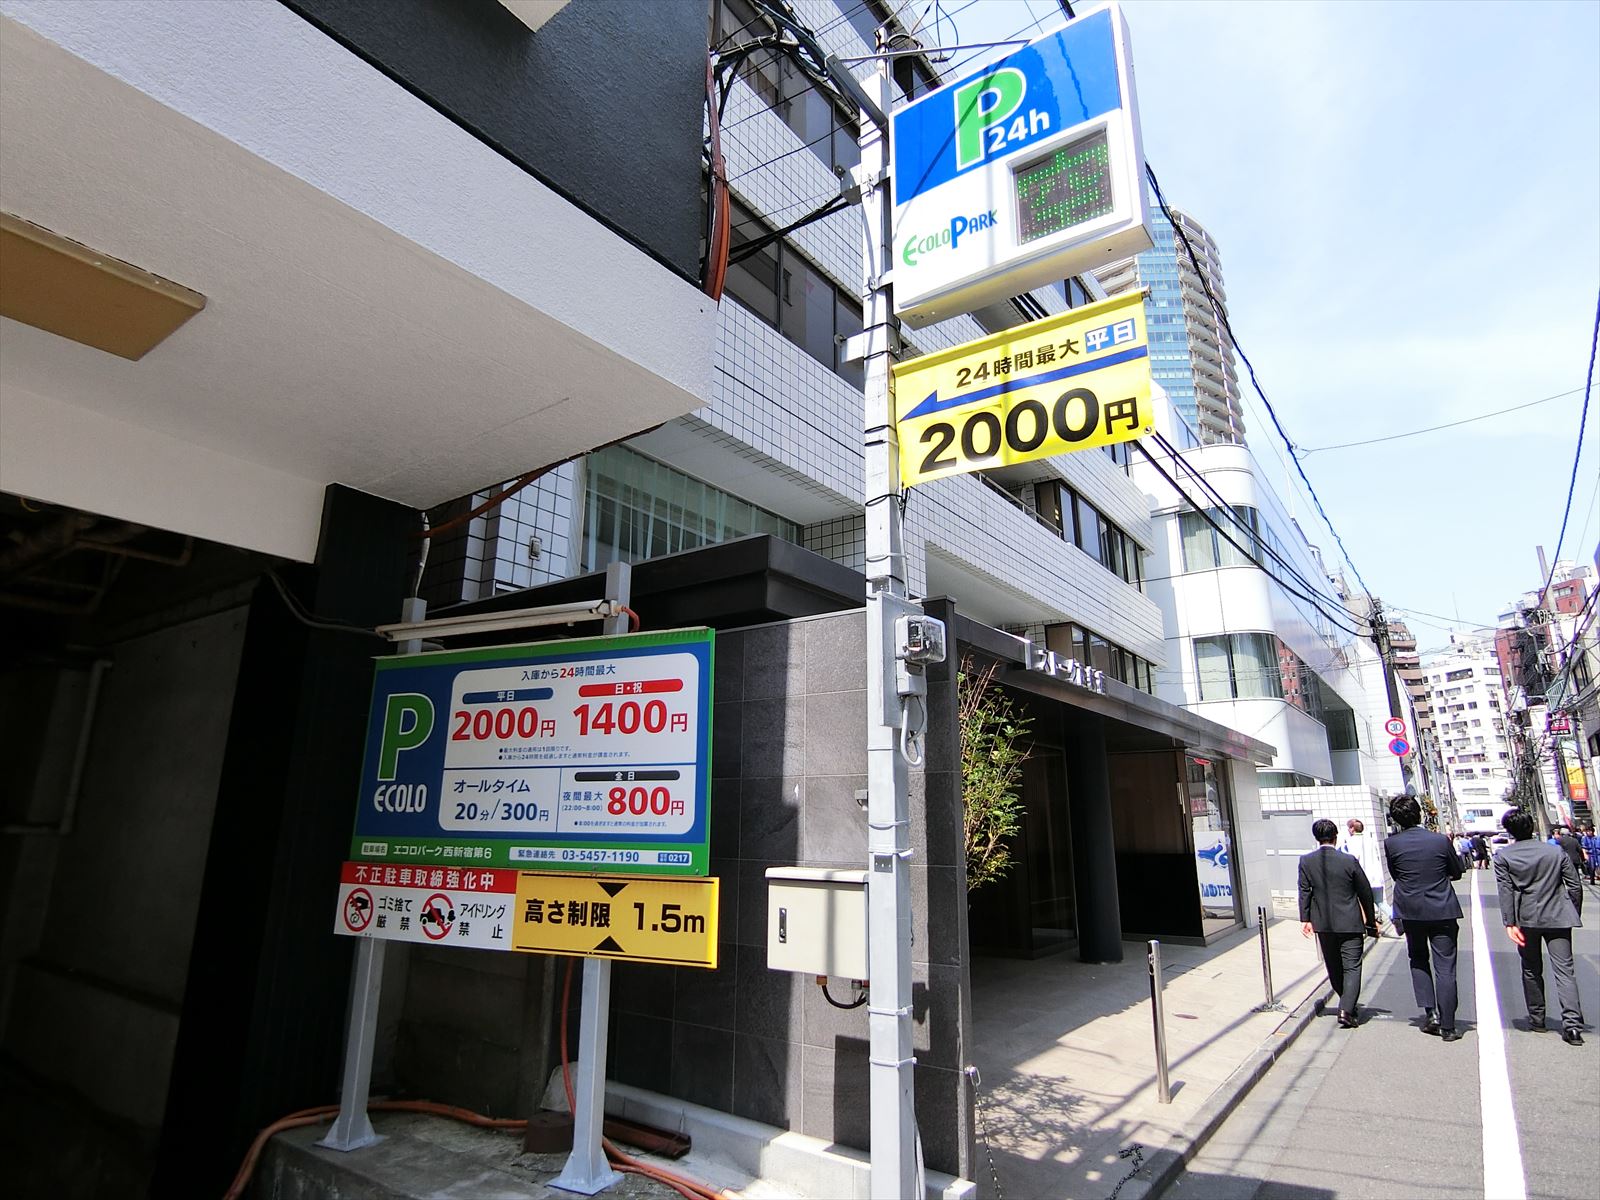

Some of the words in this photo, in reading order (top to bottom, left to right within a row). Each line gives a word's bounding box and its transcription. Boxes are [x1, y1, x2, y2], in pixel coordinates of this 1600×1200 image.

[953, 67, 1027, 172] P
[987, 108, 1050, 154] 24h
[956, 339, 1079, 388] 24時間最大
[1085, 319, 1136, 351] 平日
[918, 387, 1140, 475] 2000円
[497, 690, 515, 701] 平日
[452, 706, 556, 740] 2000円
[573, 699, 688, 736] 1400円
[1389, 723, 1402, 731] 30
[377, 692, 435, 781] P
[374, 784, 427, 813] ECOLO
[453, 779, 531, 793] オールタイム
[563, 791, 603, 801] 夜間最大
[607, 786, 685, 816] 800円
[393, 845, 492, 859] エコロパーク西新宿第6
[562, 850, 639, 862] 03-5457-1190
[668, 853, 688, 863] 0217
[355, 865, 495, 891] 不正駐車取締強化中
[378, 895, 413, 912] ゴミ捨て
[460, 903, 506, 919] アイドリング
[524, 899, 611, 928] 高さ制限
[633, 902, 705, 934] 1.5m
